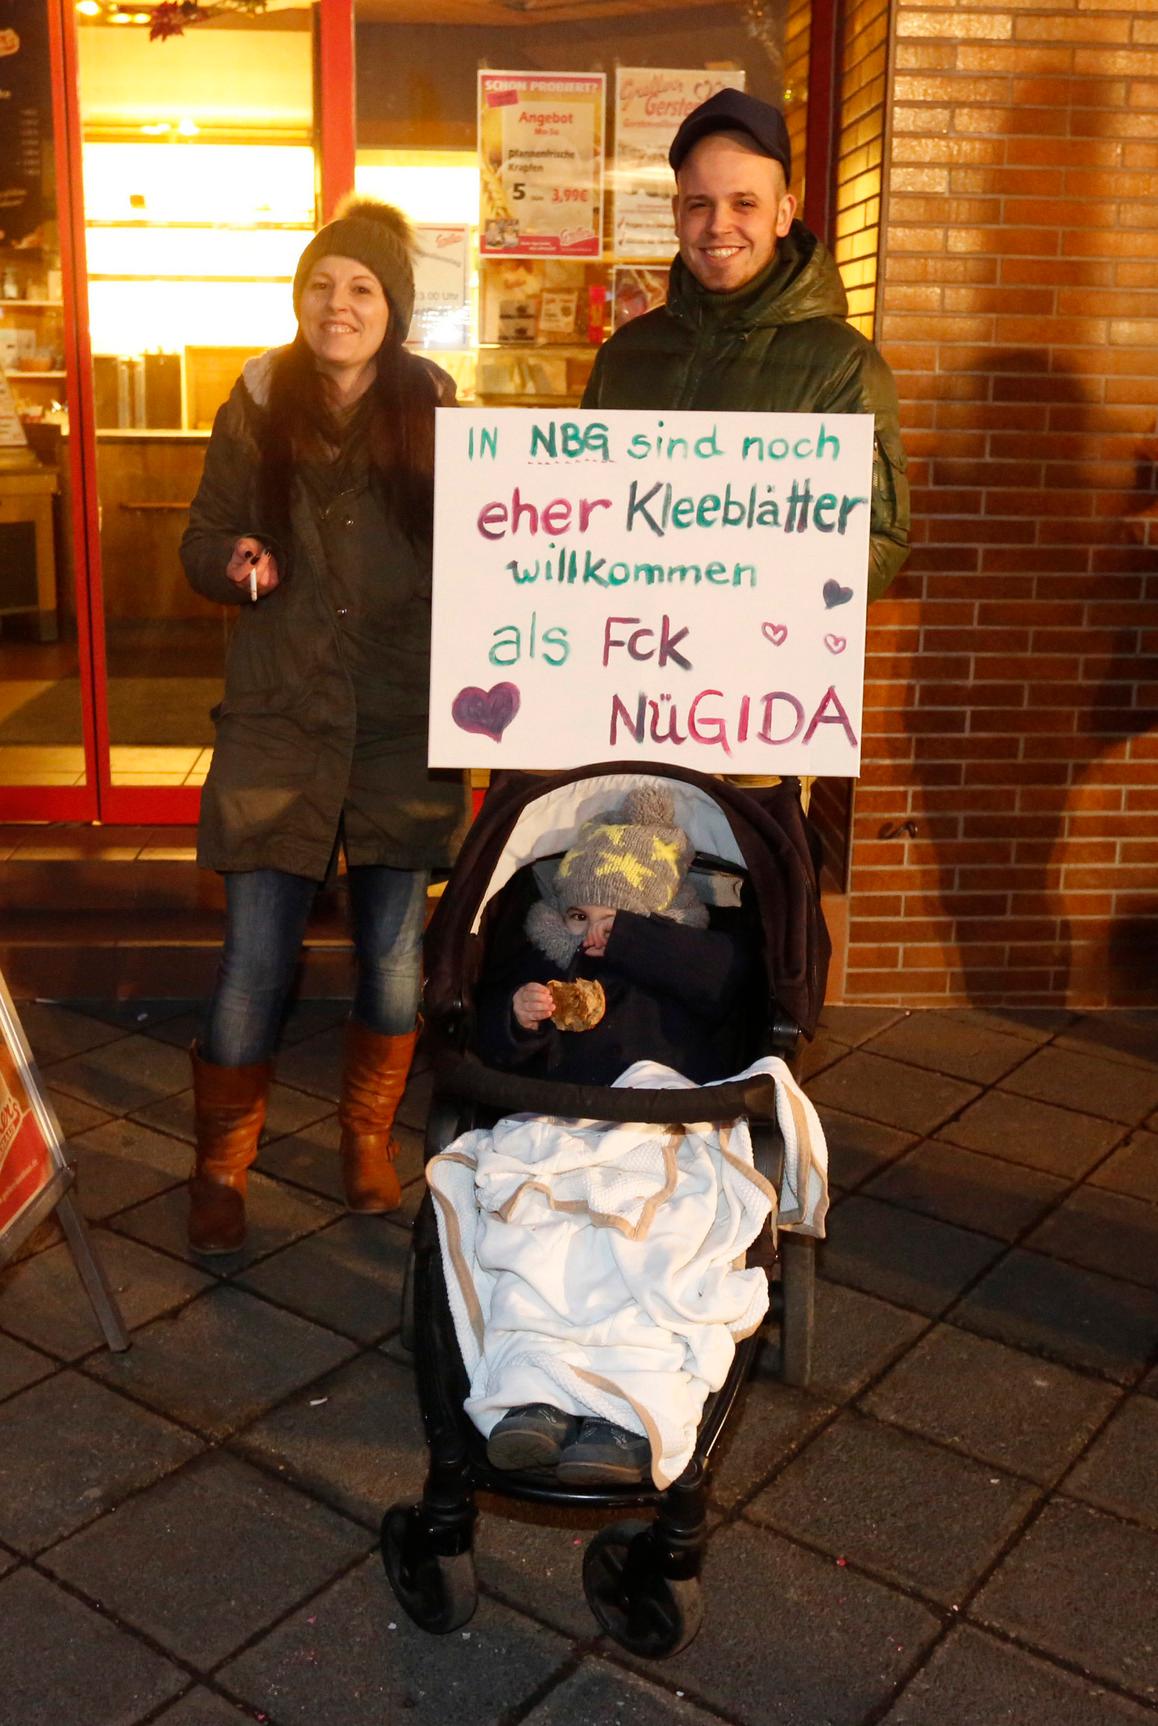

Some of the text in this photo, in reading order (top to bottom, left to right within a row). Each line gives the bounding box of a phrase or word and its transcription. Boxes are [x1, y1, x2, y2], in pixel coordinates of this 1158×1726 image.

[519, 111, 573, 126] Angebot
[513, 183, 525, 200] 5
[468, 421, 840, 461] IN NBG sind noch
[477, 478, 868, 541] eher Kleeblätter
[506, 543, 758, 588] willkommen
[488, 611, 693, 671] als Fck
